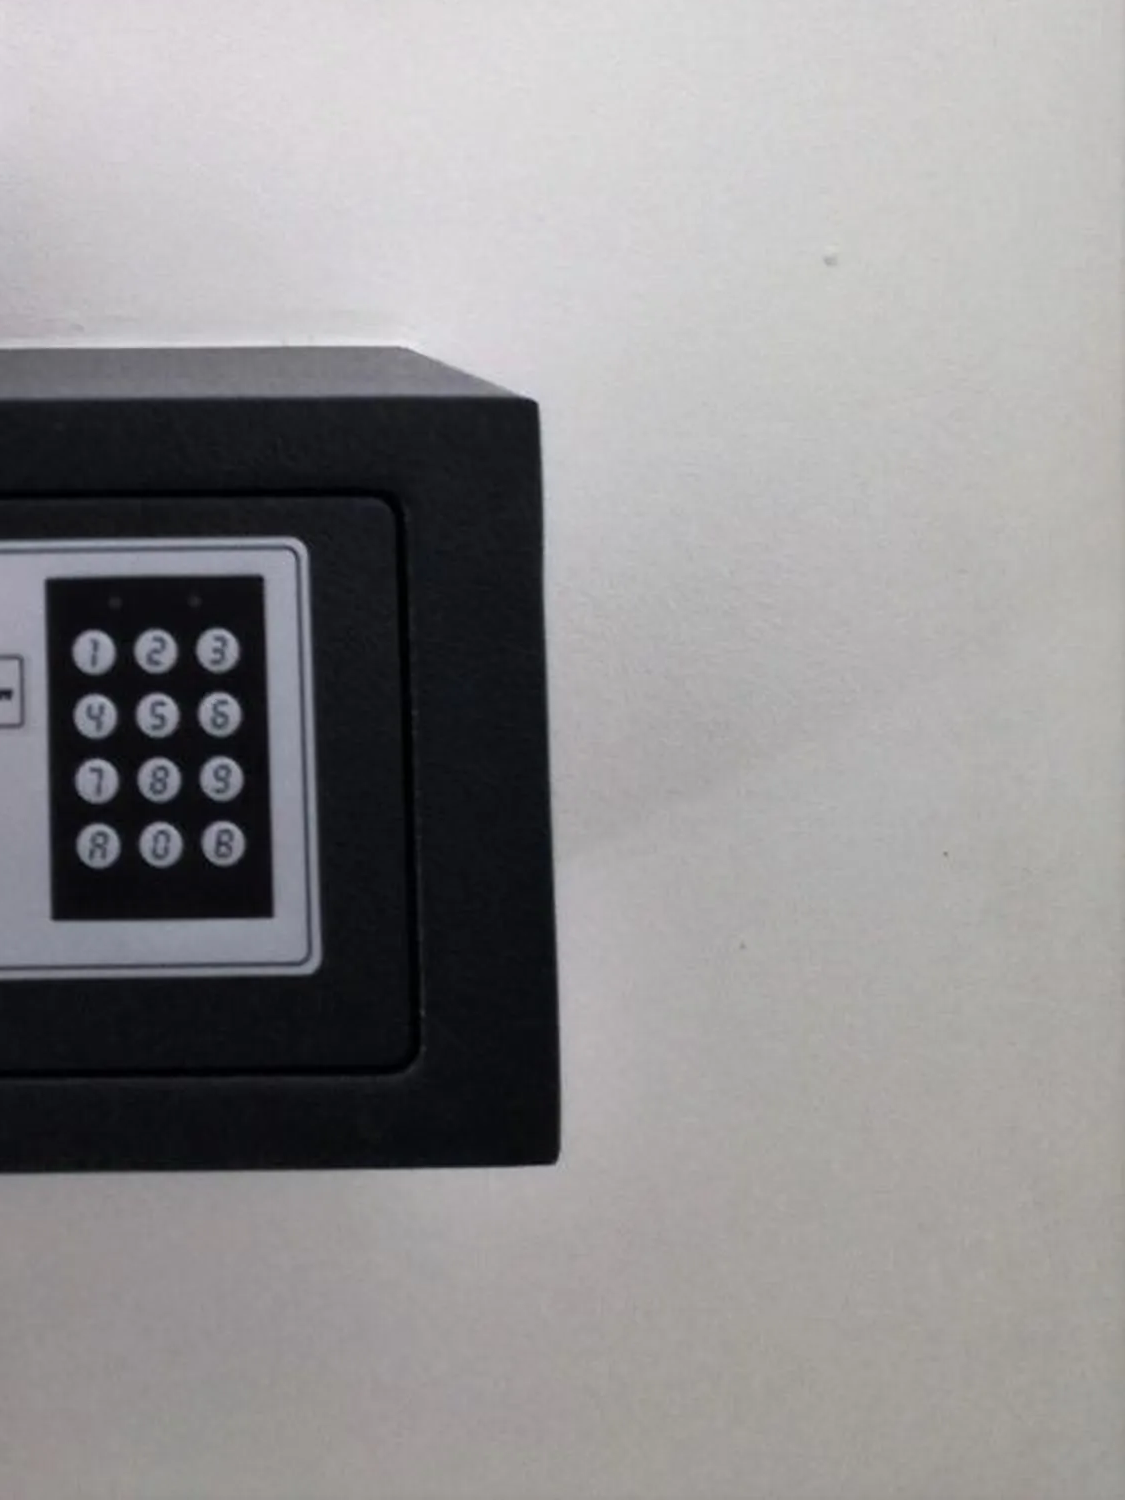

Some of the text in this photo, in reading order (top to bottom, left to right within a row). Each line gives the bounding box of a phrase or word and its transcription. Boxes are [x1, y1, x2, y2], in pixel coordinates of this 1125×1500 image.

[90, 635, 228, 667] 1 2 3
[85, 699, 230, 733] 4 5 6
[88, 763, 232, 797] 7 8 9
[88, 828, 234, 862] A 0 B
